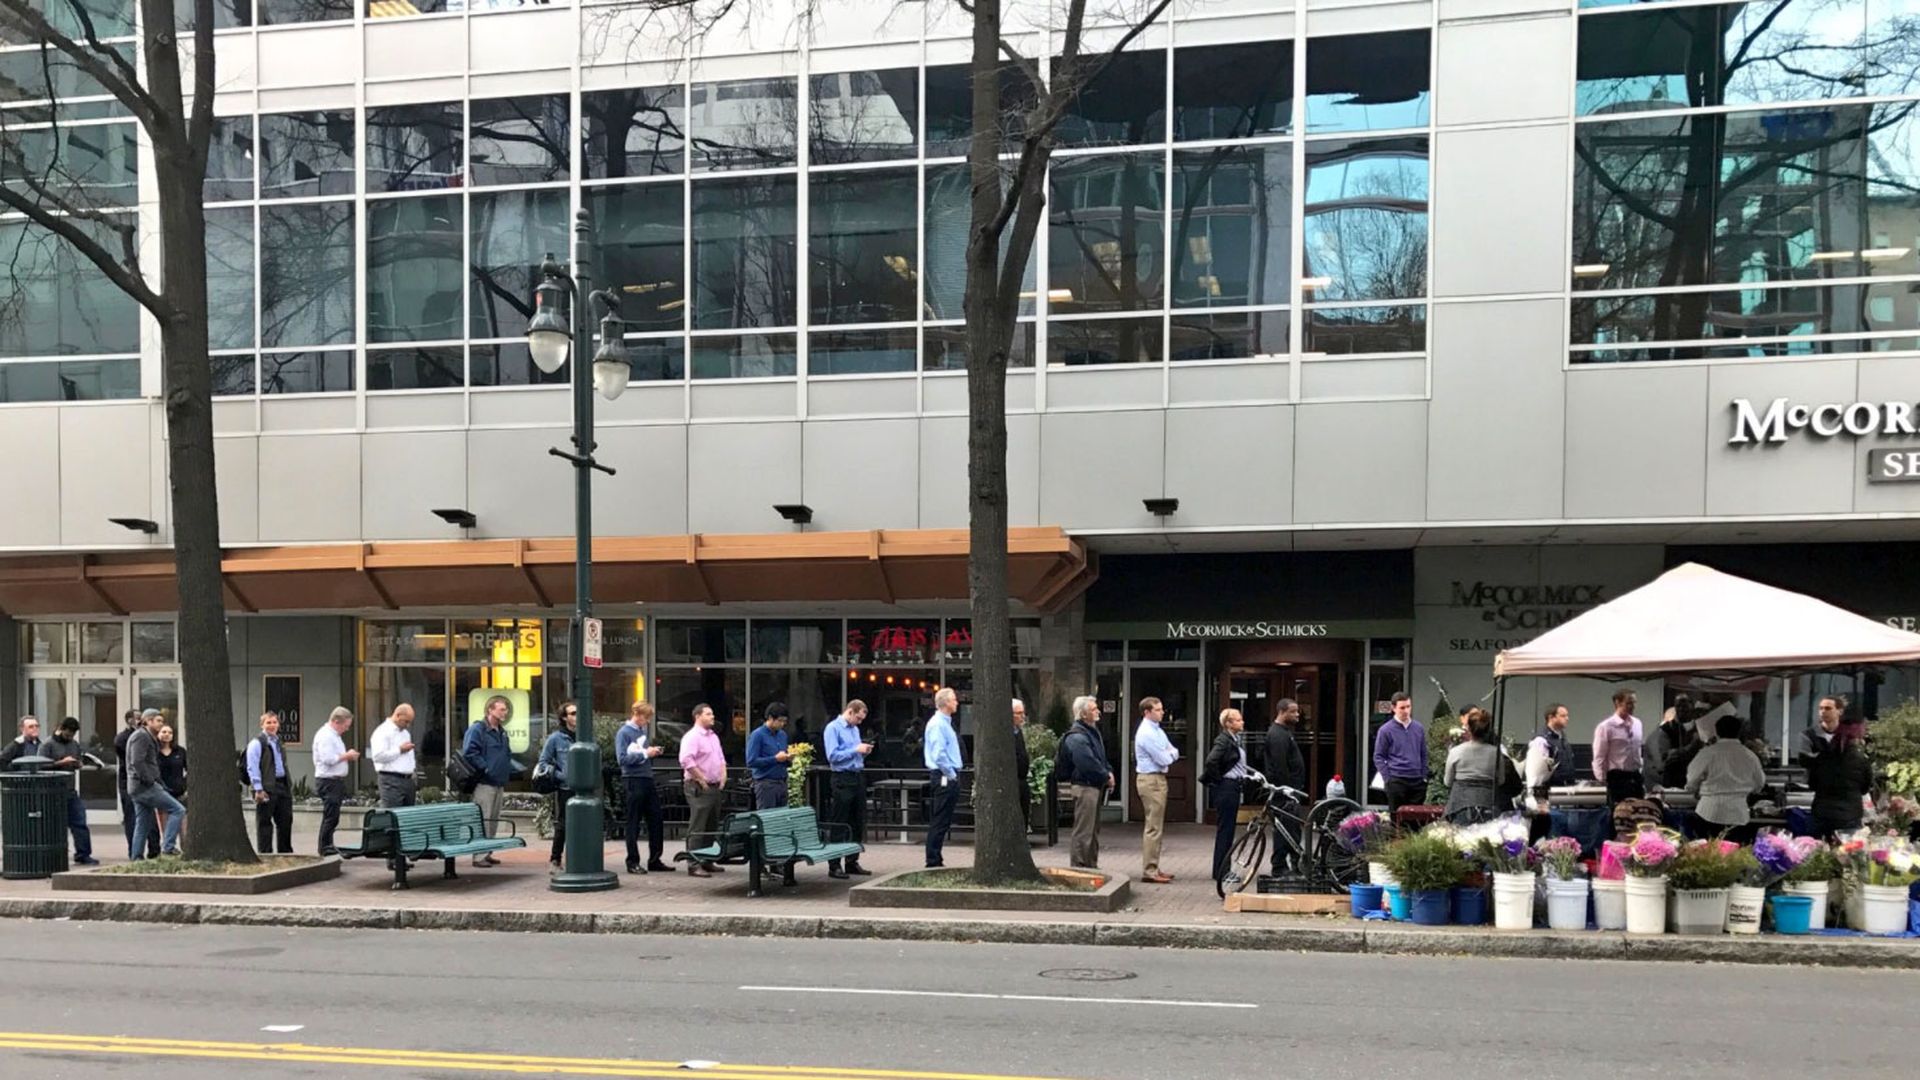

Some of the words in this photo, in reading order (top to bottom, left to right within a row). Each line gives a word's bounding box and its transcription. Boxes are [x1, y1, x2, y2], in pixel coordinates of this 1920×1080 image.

[1728, 398, 1920, 443] McCOR
[1884, 452, 1920, 477] SE
[1886, 616, 1920, 633] SE
[609, 636, 639, 646] LUNCH
[278, 709, 298, 724] 00
[507, 730, 528, 738] UTS
